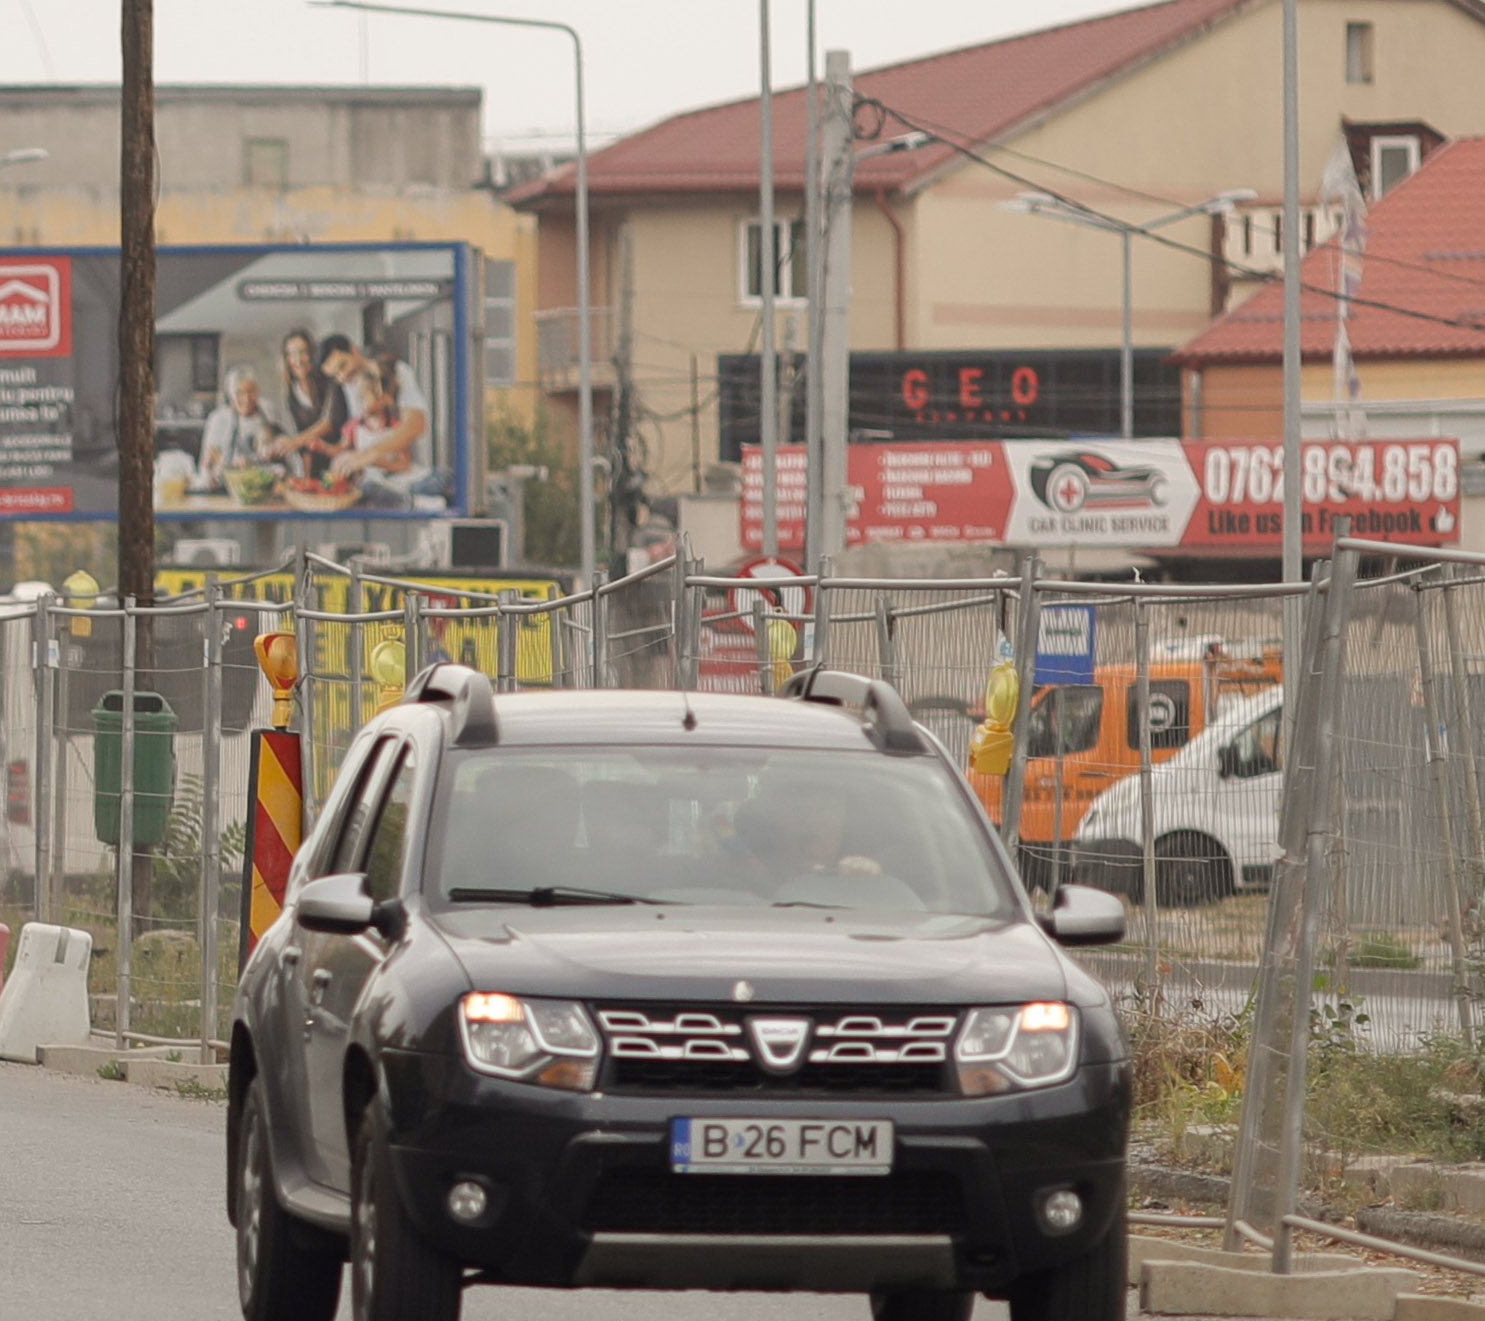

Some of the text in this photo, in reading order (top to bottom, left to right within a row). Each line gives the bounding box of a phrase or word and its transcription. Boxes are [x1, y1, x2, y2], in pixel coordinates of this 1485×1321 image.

[902, 366, 1039, 409] GEO
[1063, 517, 1105, 531] CLINIC
[1111, 516, 1169, 531] SERVICE
[1208, 509, 1251, 534] Like
[1257, 514, 1282, 533] us
[703, 1124, 729, 1158] B
[744, 1125, 786, 1159] 26
[799, 1125, 878, 1159] FCM
